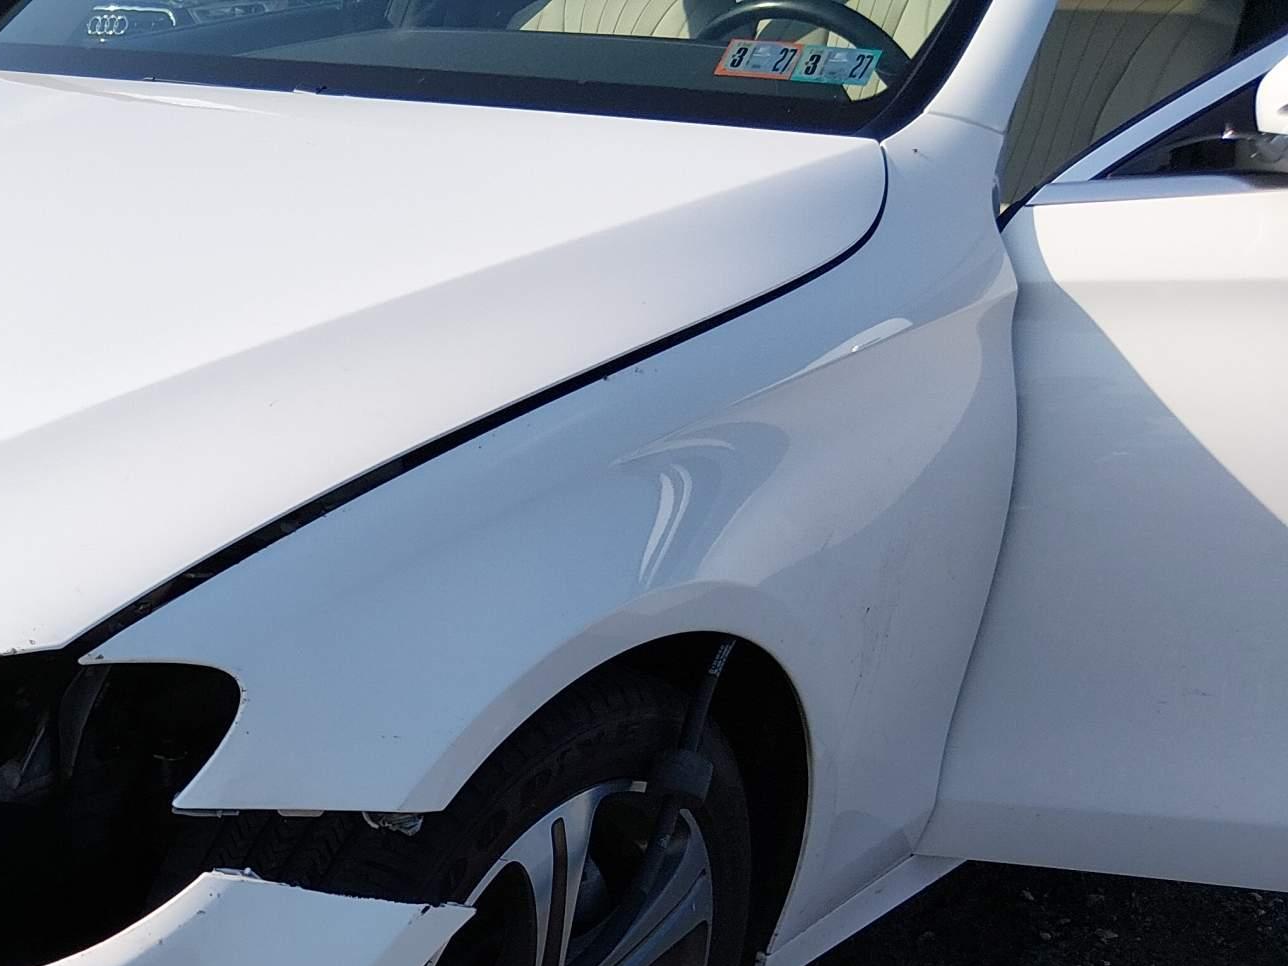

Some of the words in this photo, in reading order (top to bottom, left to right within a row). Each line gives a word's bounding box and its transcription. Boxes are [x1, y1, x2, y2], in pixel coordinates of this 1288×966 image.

[730, 47, 748, 68] 3
[772, 48, 798, 74] 27
[804, 54, 821, 76] 3
[848, 54, 874, 79] 27
